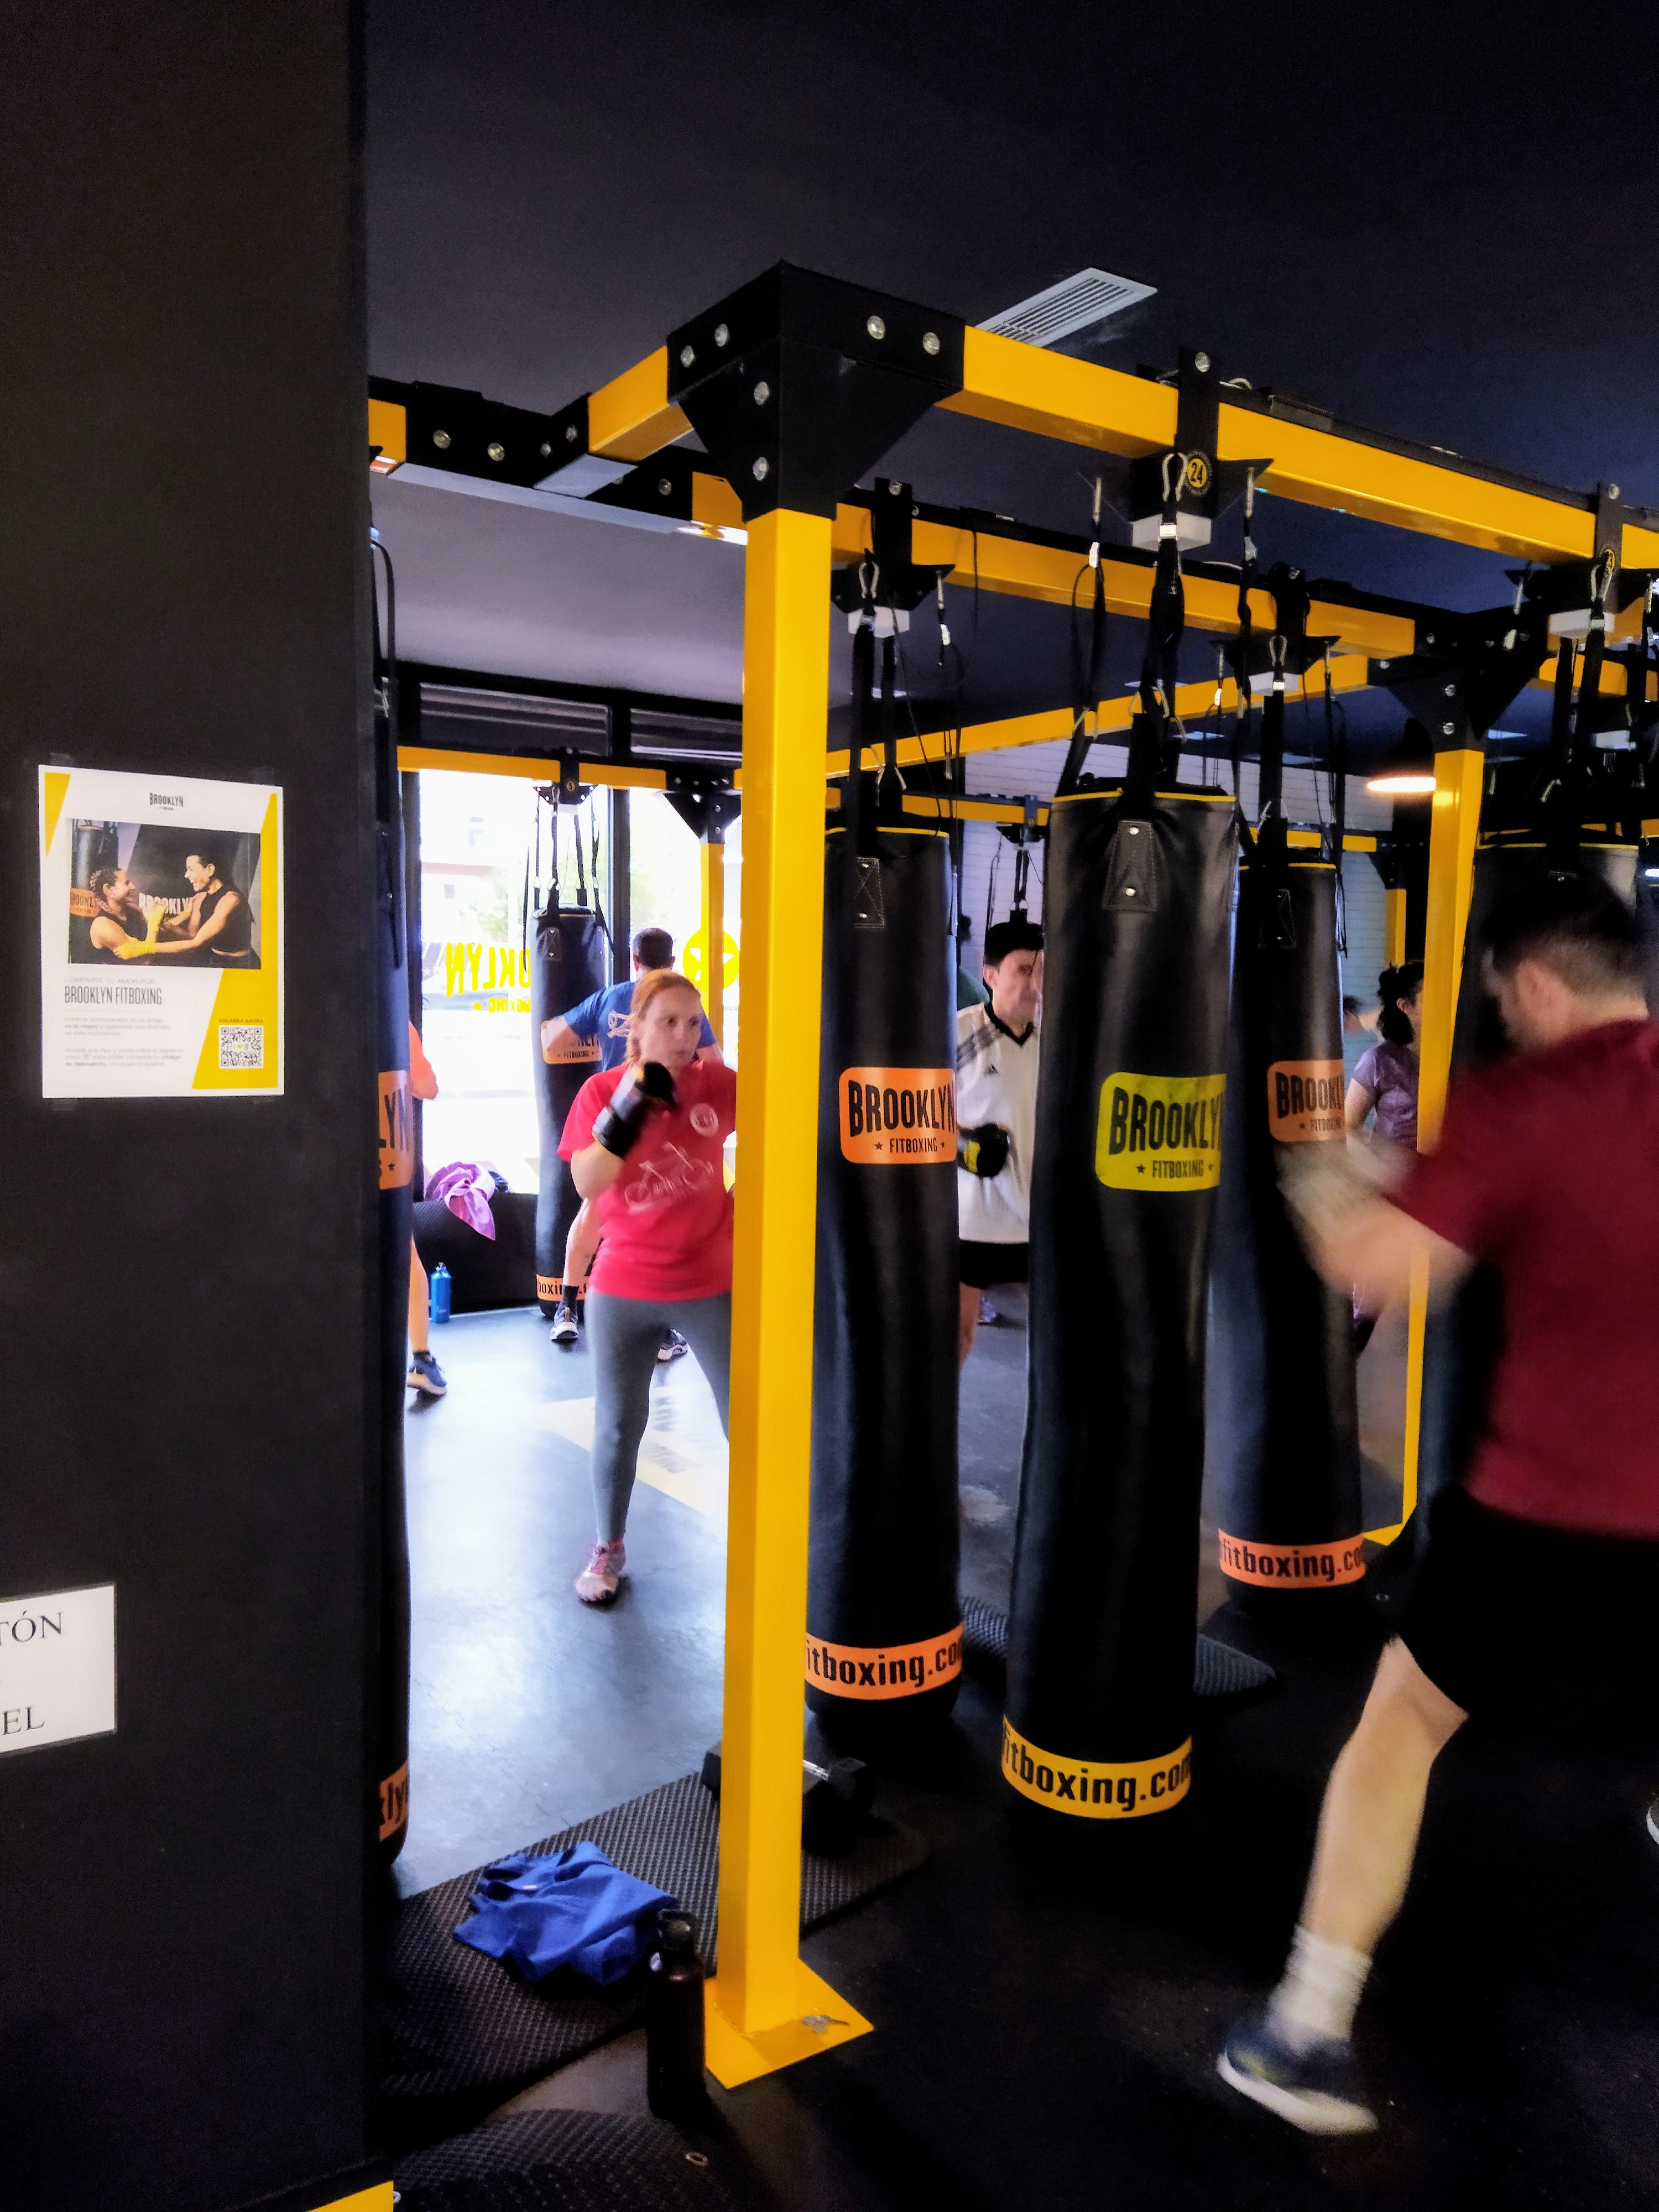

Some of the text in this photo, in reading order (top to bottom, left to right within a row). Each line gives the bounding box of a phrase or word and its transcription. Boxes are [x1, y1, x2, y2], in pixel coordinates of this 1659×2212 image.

[1190, 461, 1203, 484] 24
[149, 792, 184, 808] BROOKLYN
[65, 986, 162, 1005] BROOKLYN FITBOXING
[848, 1079, 955, 1137] BROOKLYN
[889, 1138, 937, 1153] FITBOXING
[1152, 1160, 1203, 1178] FITBOXING
[3, 1706, 45, 1735] EL
